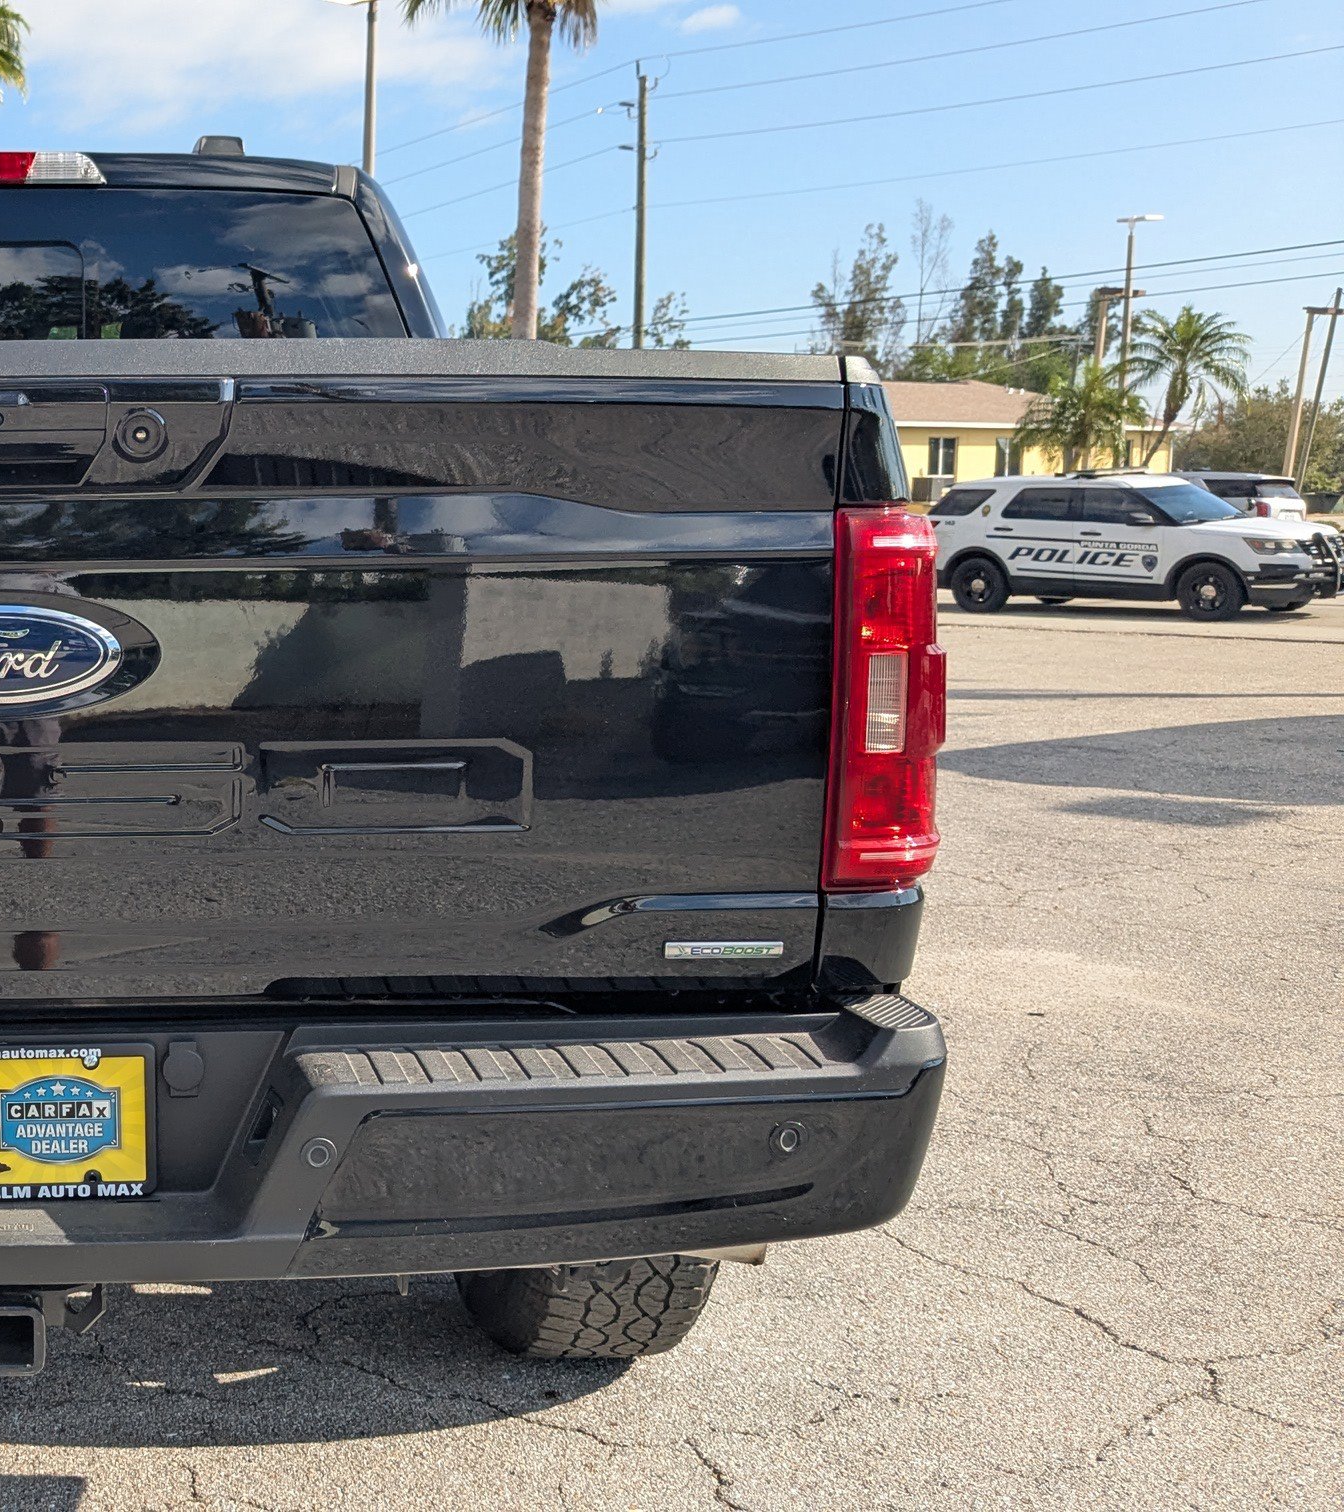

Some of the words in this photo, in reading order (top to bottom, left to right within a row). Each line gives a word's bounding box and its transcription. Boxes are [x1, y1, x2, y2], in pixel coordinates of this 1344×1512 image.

[1080, 540, 1117, 549] PUNTA
[1007, 546, 1140, 567] POLICE
[9, 1102, 109, 1119] CARFAX
[16, 1122, 103, 1138] ADVANTAGE
[31, 1139, 88, 1155] DEALER
[37, 1184, 90, 1198] AUTO
[97, 1183, 144, 1197] MAX
